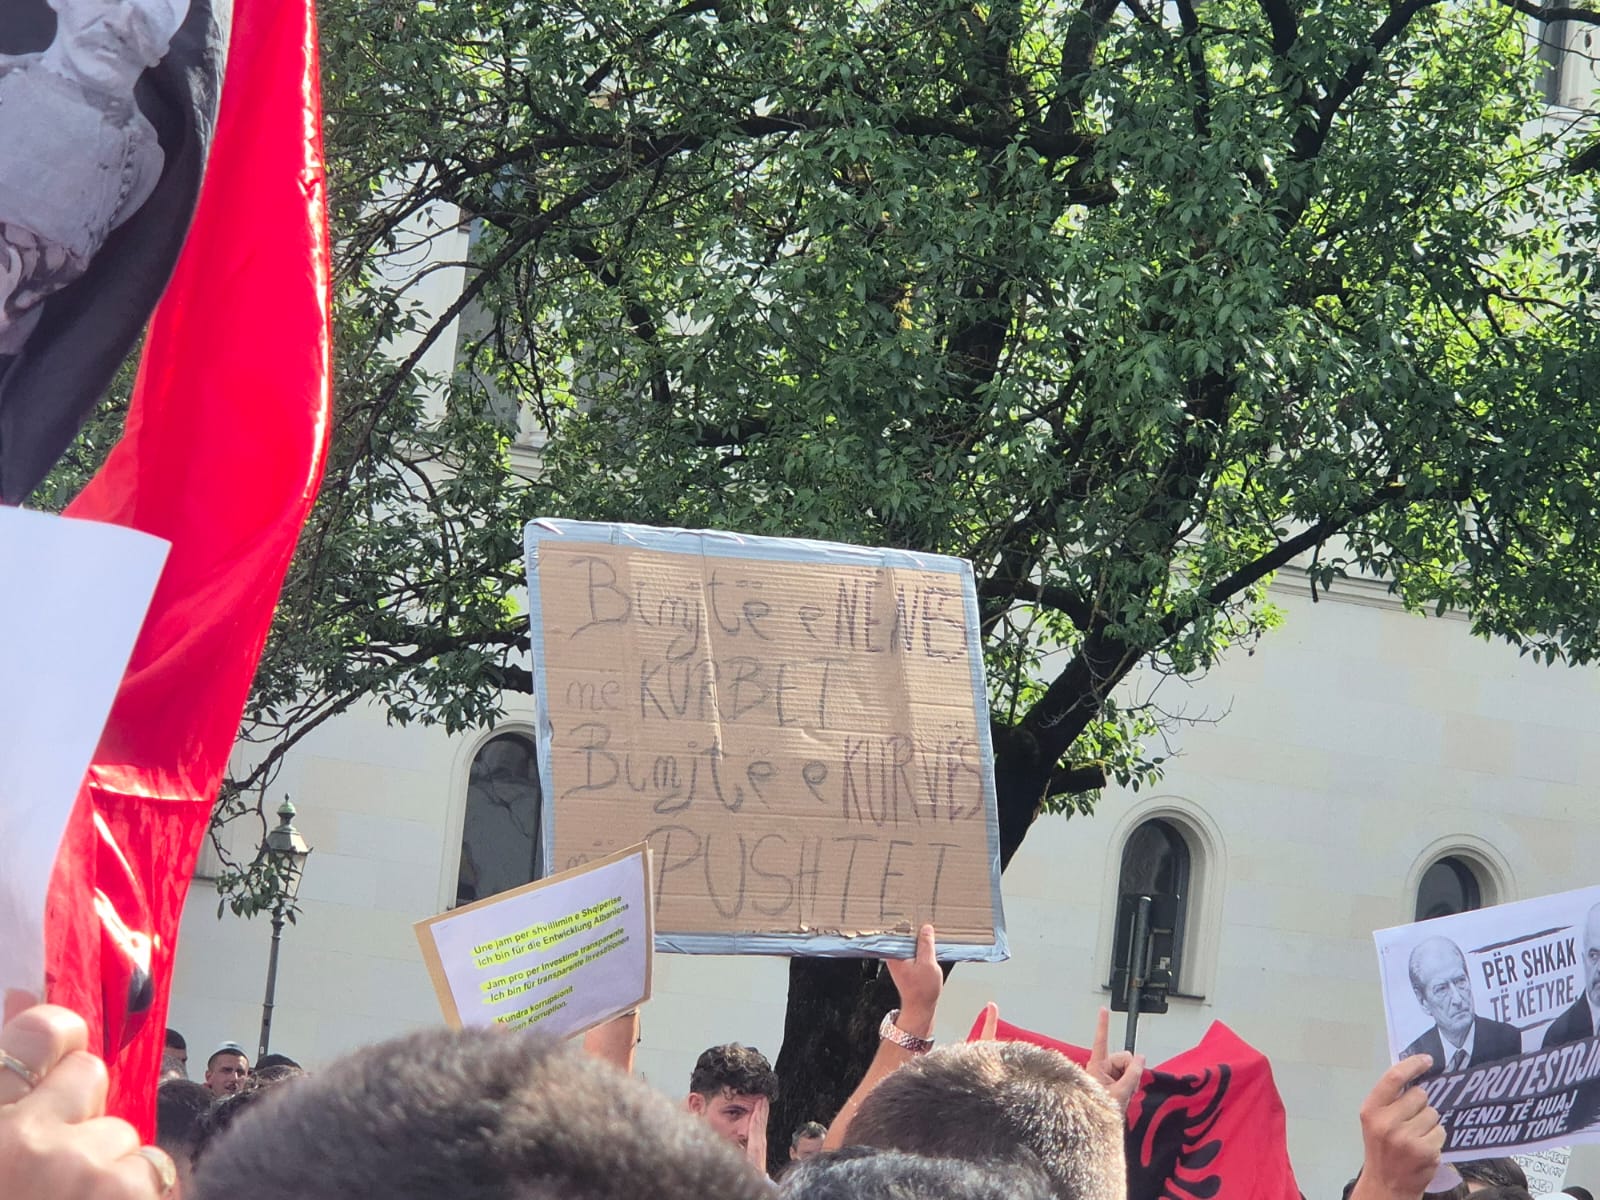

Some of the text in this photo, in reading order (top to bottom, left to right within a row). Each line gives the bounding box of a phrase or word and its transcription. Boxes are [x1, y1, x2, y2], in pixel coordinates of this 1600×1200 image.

[802, 760, 828, 803] e
[647, 825, 960, 924] PUSHTET
[474, 943, 494, 954] Une
[495, 936, 513, 950] jam
[514, 930, 529, 942] per
[478, 956, 493, 967] Ich
[495, 950, 510, 961] bin
[527, 941, 541, 951] die
[542, 920, 593, 945] Entwicklung
[487, 978, 507, 990] Jam
[508, 973, 524, 984] pro
[526, 966, 540, 979] per
[1482, 937, 1577, 990] PËR SHKAK
[490, 991, 505, 1003] Ich
[507, 986, 522, 997] bin
[1490, 974, 1578, 1022] TË KËTYRE.
[497, 1008, 529, 1024] Kundra
[1420, 1074, 1463, 1109] OT
[1439, 1090, 1579, 1127] Ë VEND TË HUAJ
[1450, 1110, 1570, 1148] VENDIN TONË.
